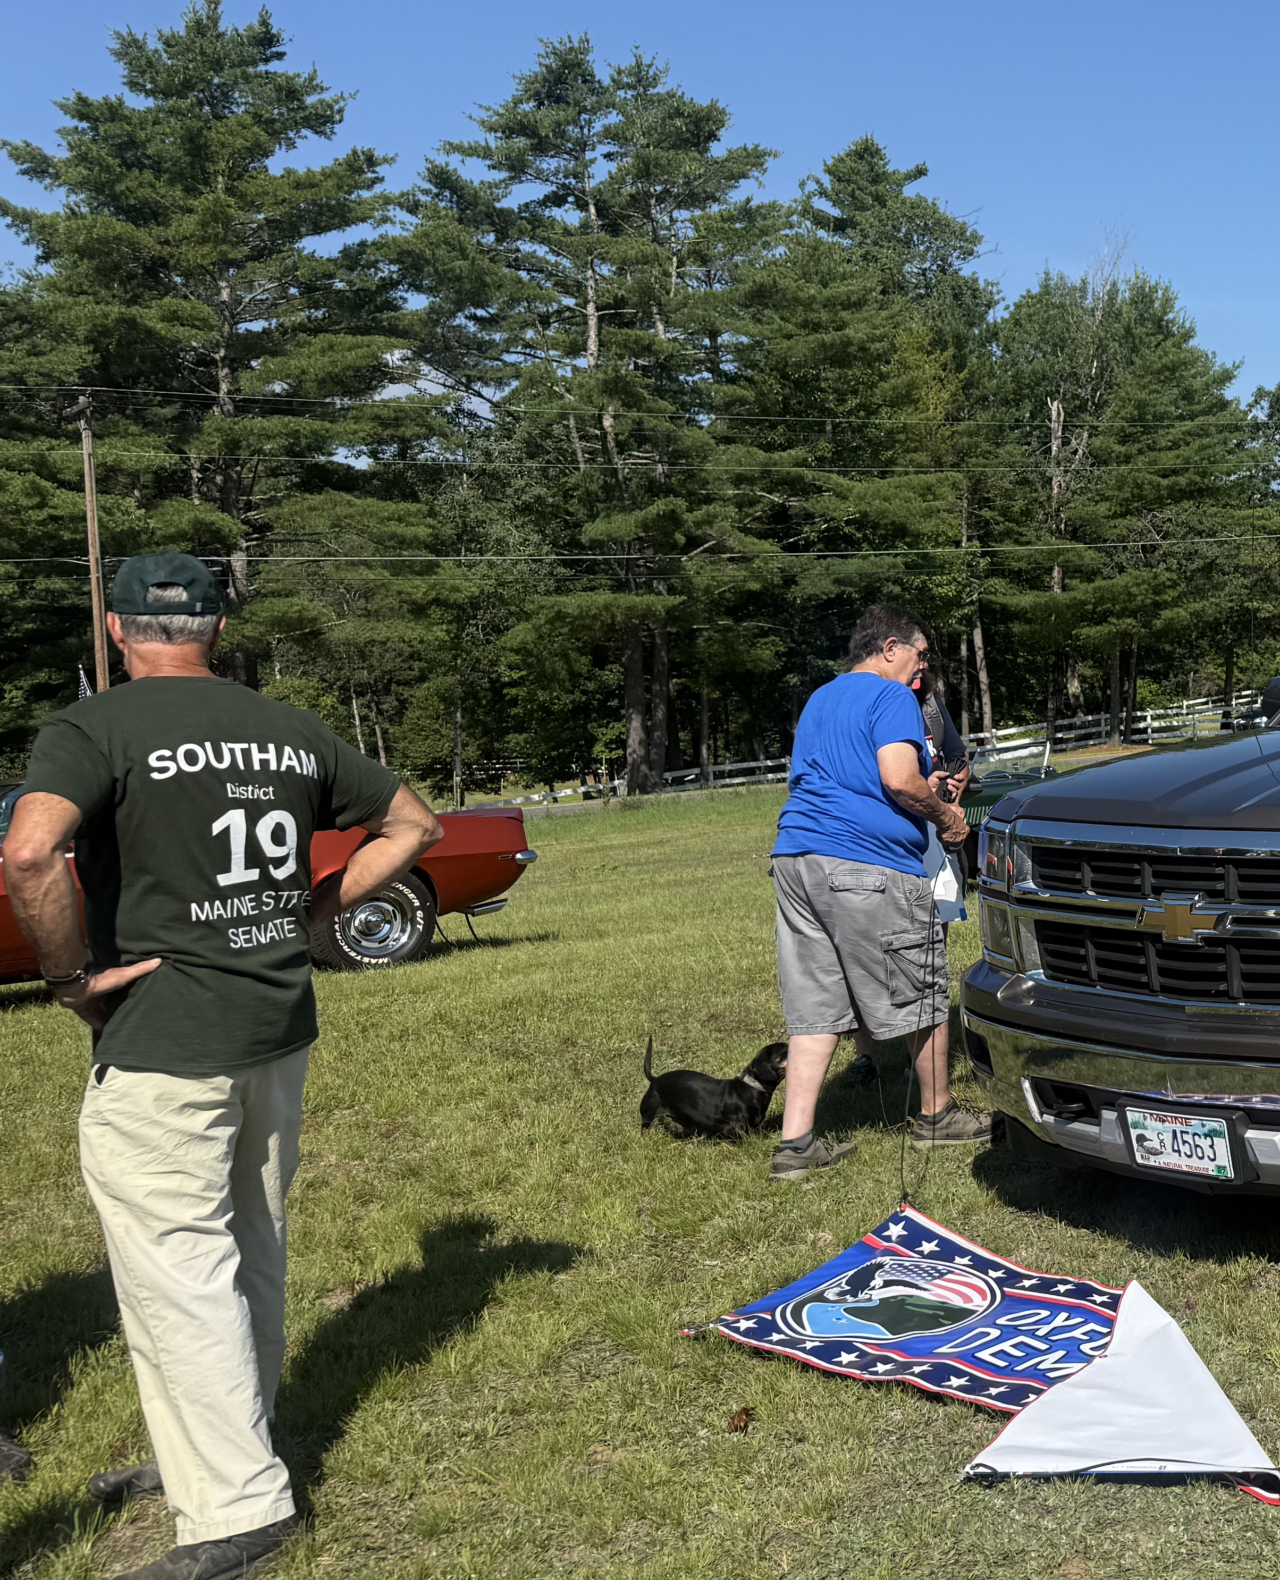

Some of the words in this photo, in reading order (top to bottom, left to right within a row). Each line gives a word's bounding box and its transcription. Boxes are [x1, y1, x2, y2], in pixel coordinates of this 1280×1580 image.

[148, 742, 317, 779] SOUTHAM
[212, 809, 298, 886] 19
[190, 894, 259, 921] MAINE
[228, 917, 296, 948] SENATE
[1150, 1113, 1193, 1127] MAINE
[1171, 1129, 1216, 1162] 4563
